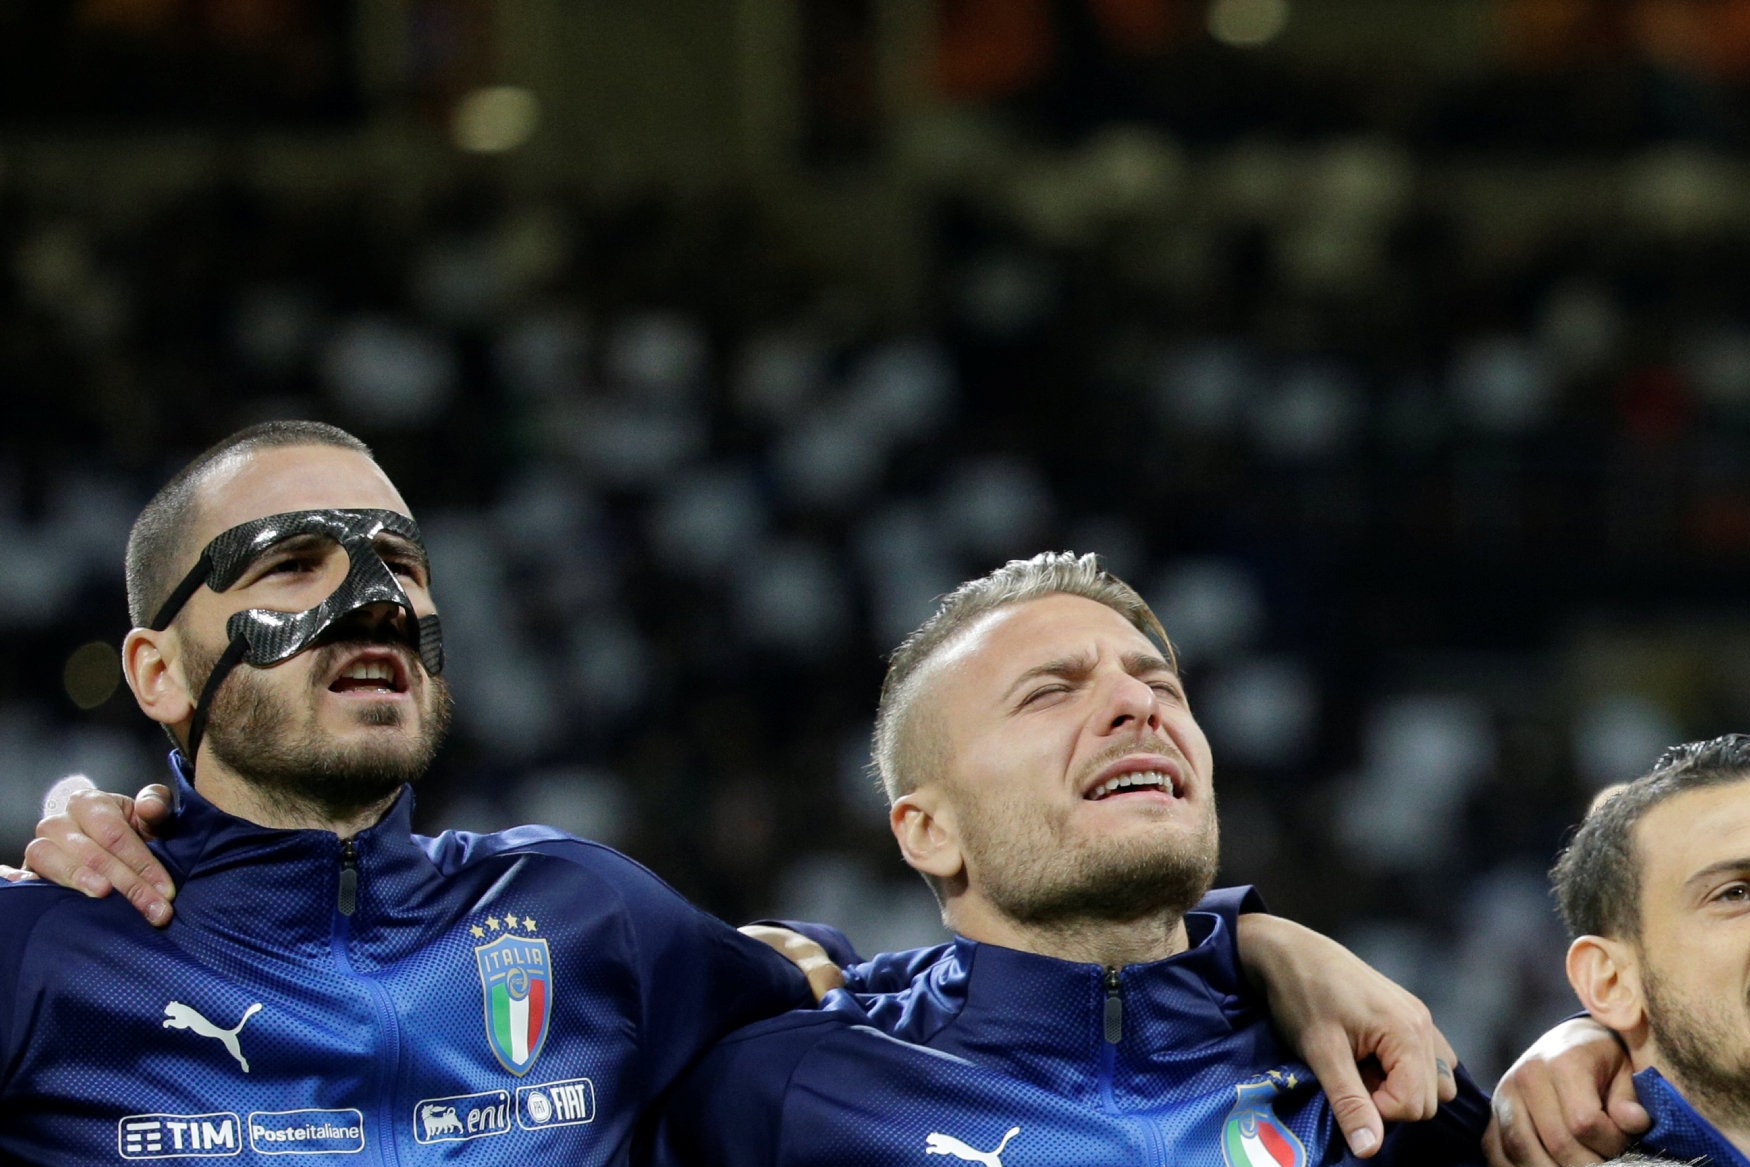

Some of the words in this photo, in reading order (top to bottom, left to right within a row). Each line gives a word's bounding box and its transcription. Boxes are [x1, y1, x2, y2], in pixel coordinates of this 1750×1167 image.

[484, 947, 543, 972] ITALIA
[467, 1093, 505, 1133] eni
[550, 1084, 586, 1121] FIAT
[166, 1120, 234, 1149] TIM
[252, 1123, 359, 1142] Posteitaliane
